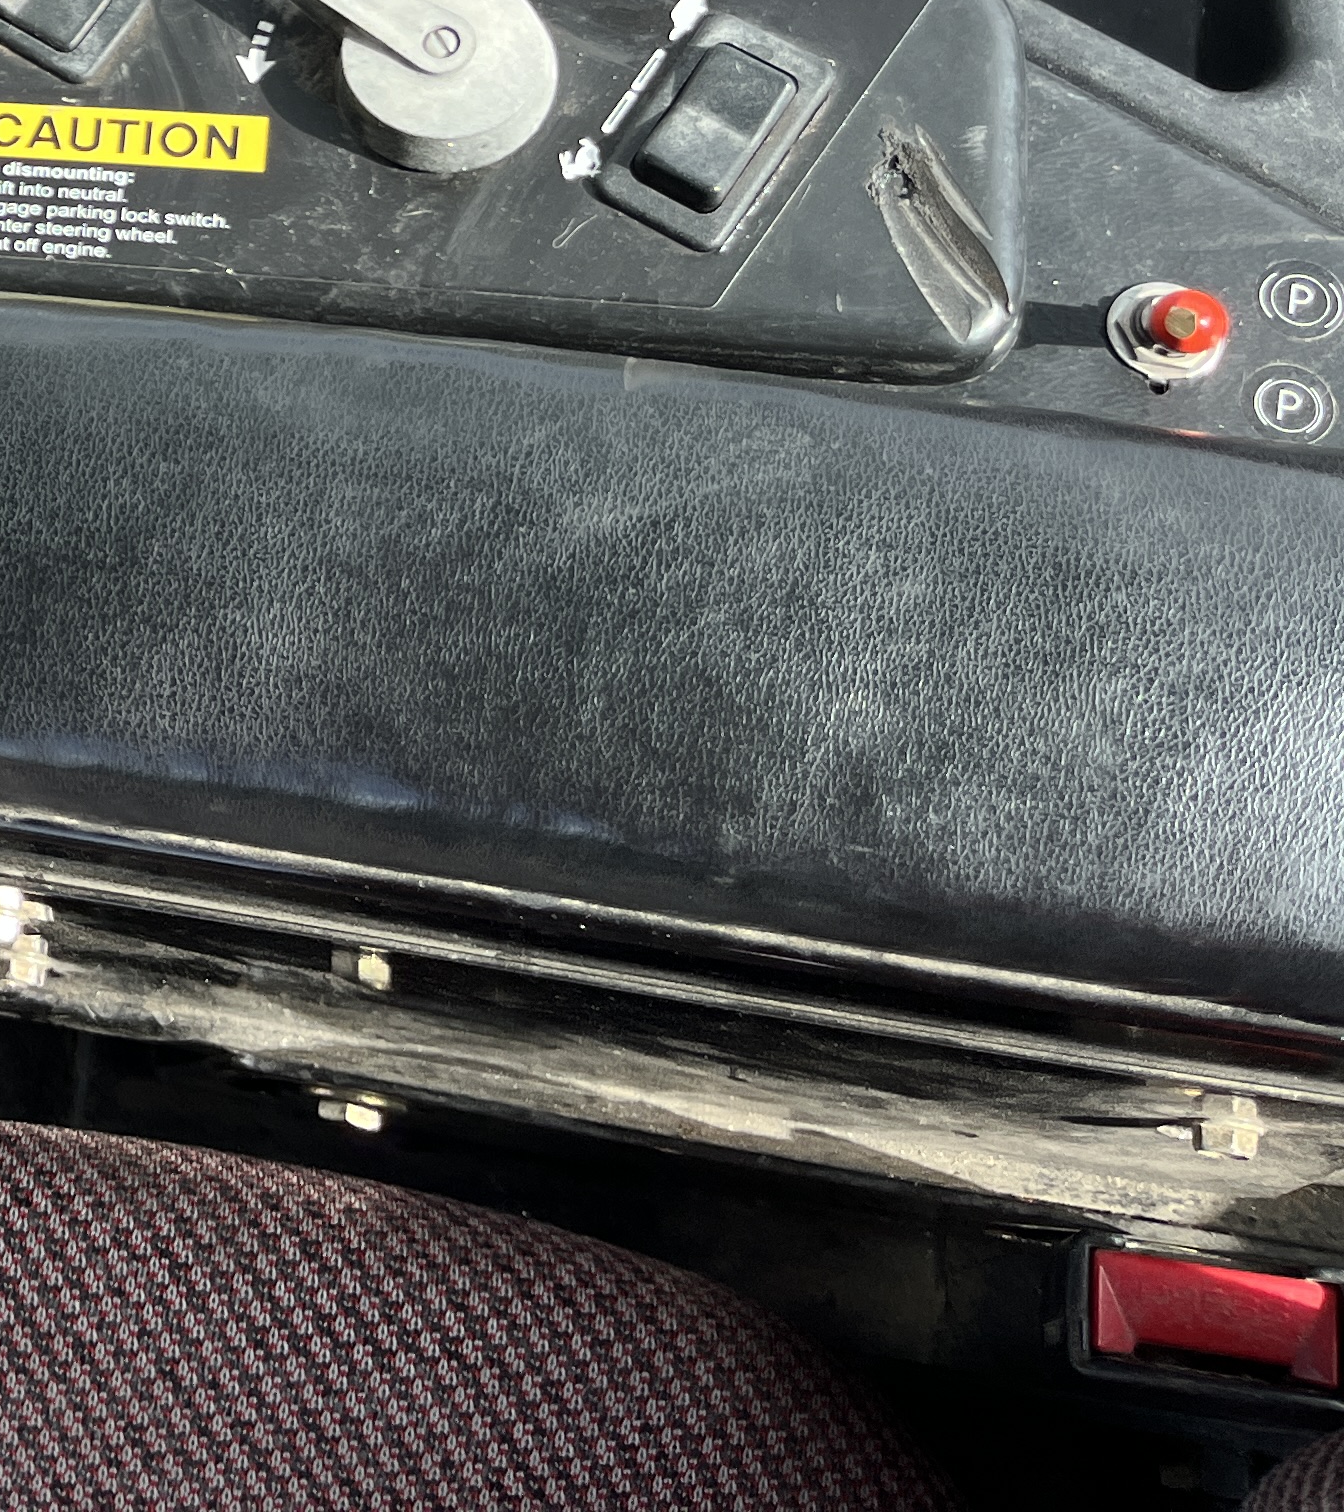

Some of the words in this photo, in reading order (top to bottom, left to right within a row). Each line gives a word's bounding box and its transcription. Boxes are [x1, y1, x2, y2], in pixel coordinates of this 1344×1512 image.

[2, 160, 136, 187] dismounting:
[18, 182, 54, 199] into
[57, 185, 128, 203] neutral.
[45, 201, 118, 224] parking
[120, 206, 161, 225] lock
[164, 210, 232, 230] switch.
[34, 220, 112, 243] steering
[115, 225, 178, 245] wheel.
[13, 236, 41, 254] off
[42, 240, 112, 261] engine.
[1288, 282, 1314, 315] P
[1276, 388, 1302, 421] P
